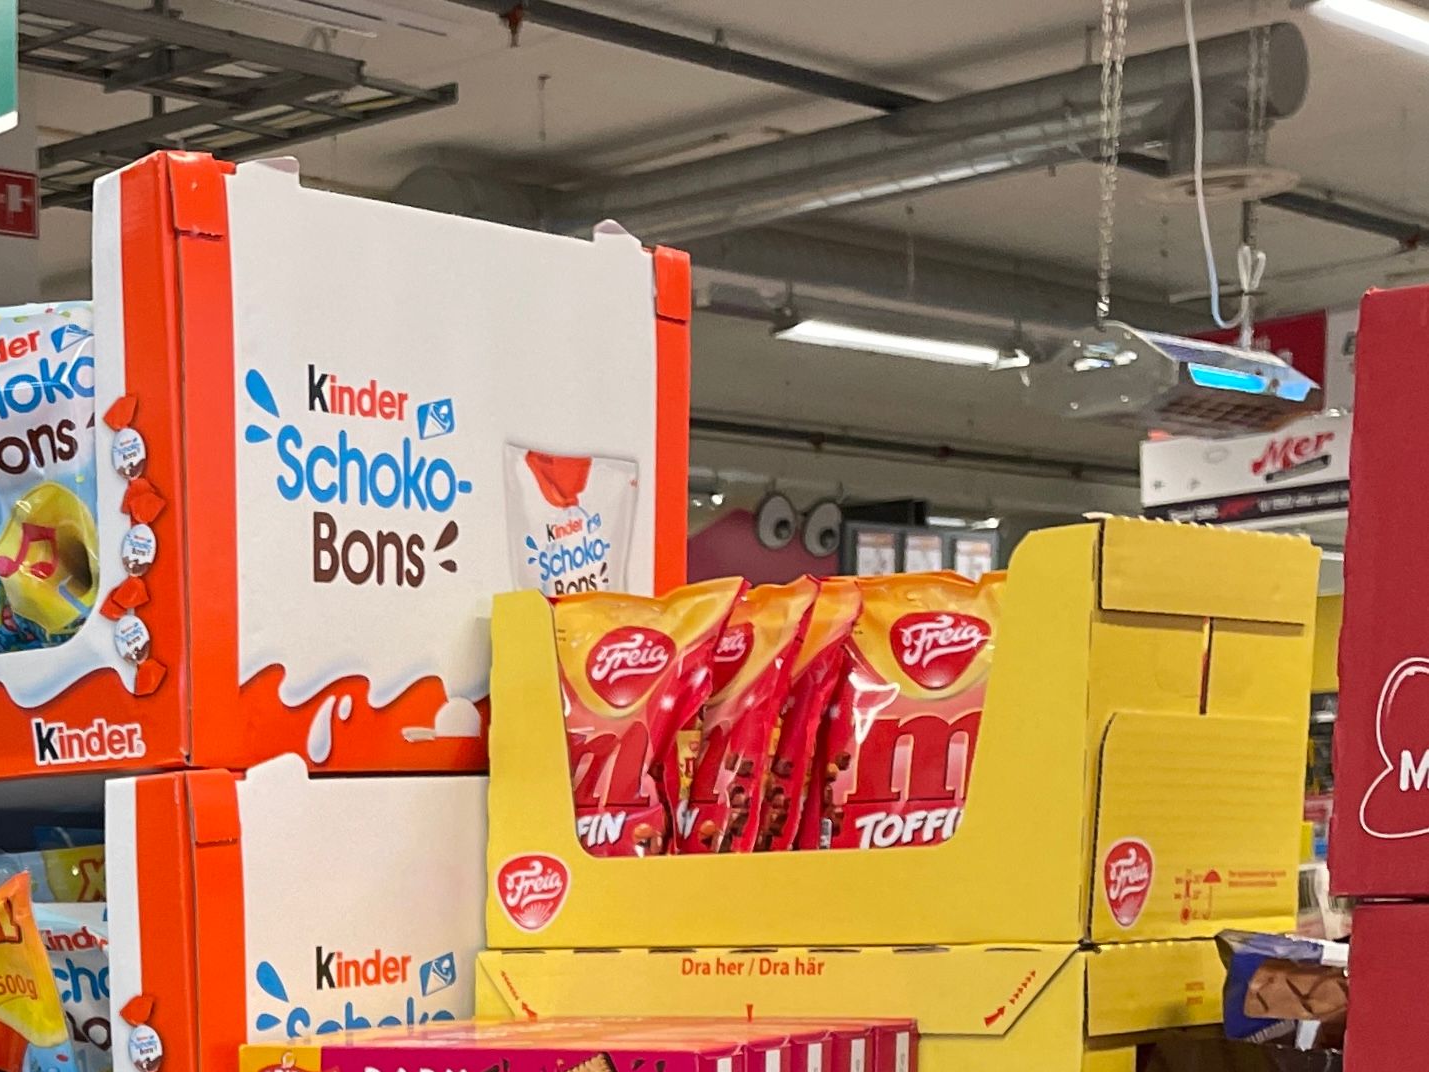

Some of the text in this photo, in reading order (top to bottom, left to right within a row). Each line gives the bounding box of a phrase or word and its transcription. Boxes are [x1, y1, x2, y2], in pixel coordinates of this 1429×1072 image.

[308, 364, 409, 421] Kinder
[276, 424, 472, 513] Schoko-
[313, 511, 425, 588] Bons
[546, 517, 583, 542] Kinder
[538, 537, 611, 581] Schoko-
[591, 633, 669, 684] Freia
[900, 614, 984, 668] Freia
[32, 719, 141, 764] Kinder
[855, 806, 963, 849] TOFFI
[507, 862, 563, 906] Freia
[315, 946, 411, 990] Kinder
[681, 957, 711, 976] Dra
[716, 956, 745, 976] her
[759, 957, 789, 976] Dra
[795, 956, 825, 976] här
